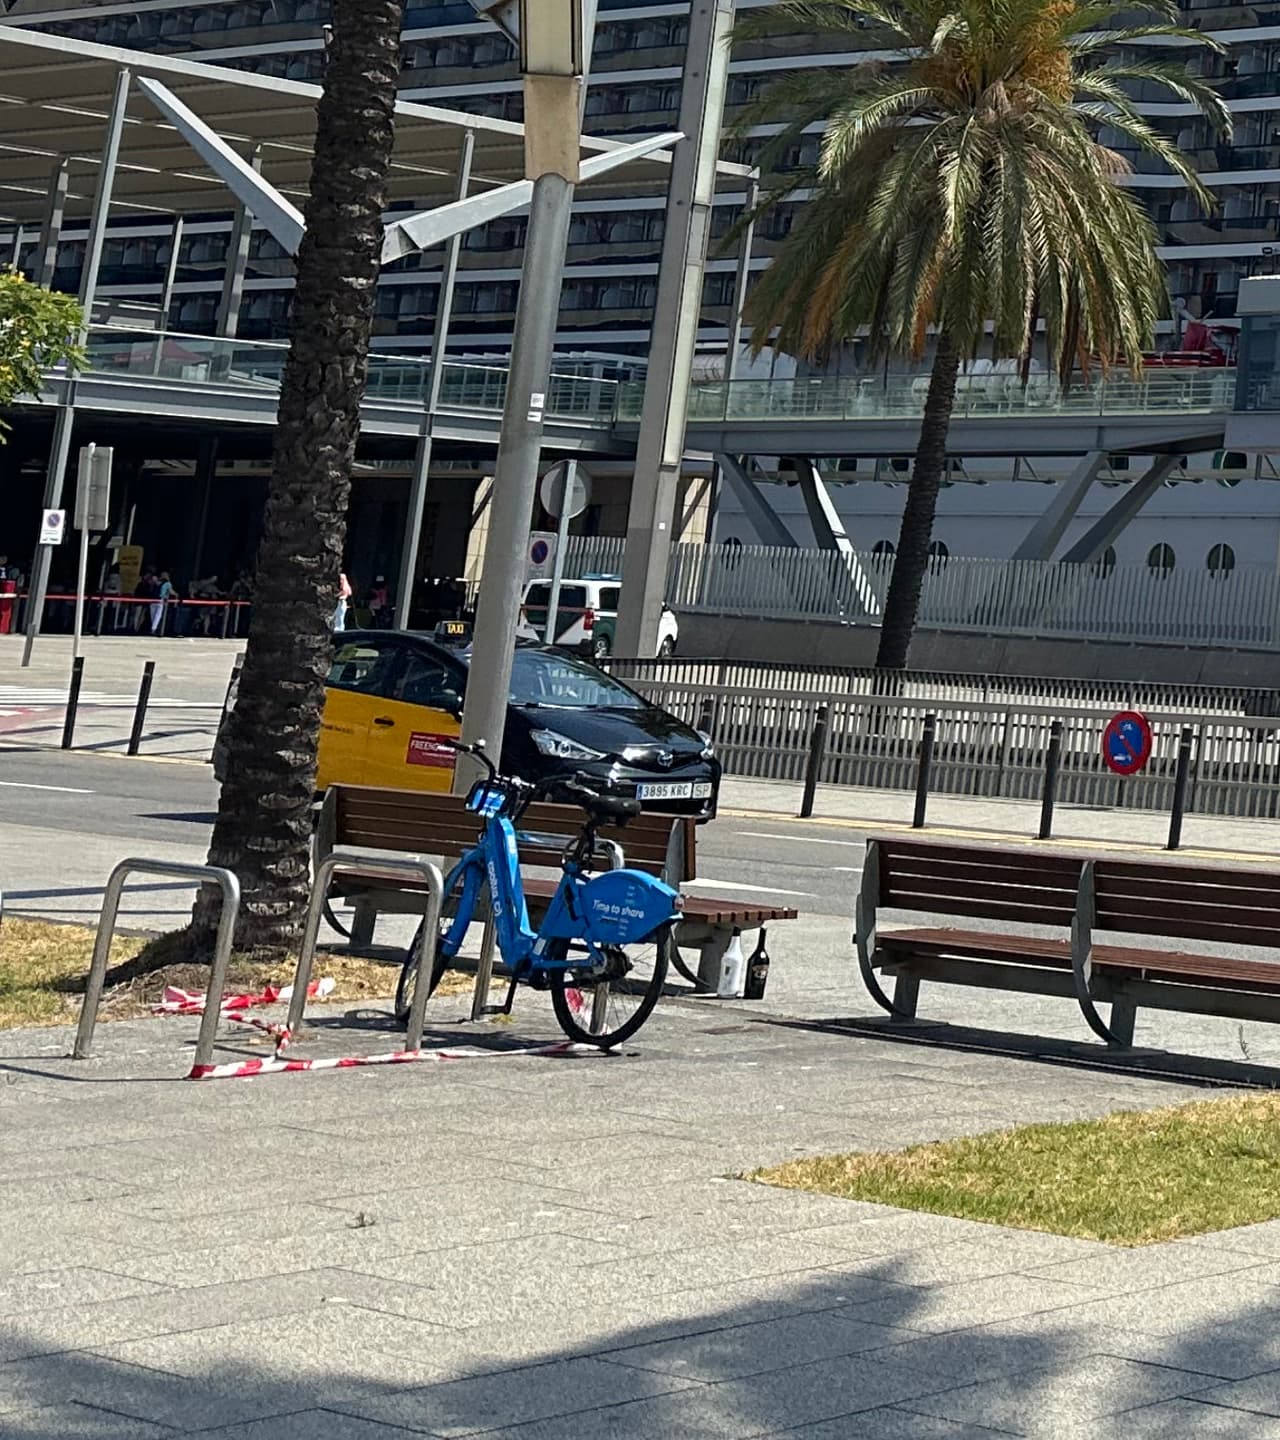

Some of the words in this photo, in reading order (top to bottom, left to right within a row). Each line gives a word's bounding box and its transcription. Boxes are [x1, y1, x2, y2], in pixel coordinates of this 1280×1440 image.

[447, 623, 464, 634] TAXI
[643, 785, 668, 797] 3895
[695, 784, 710, 796] SP
[592, 899, 610, 913] Time
[611, 904, 621, 914] to
[621, 906, 645, 919] share
